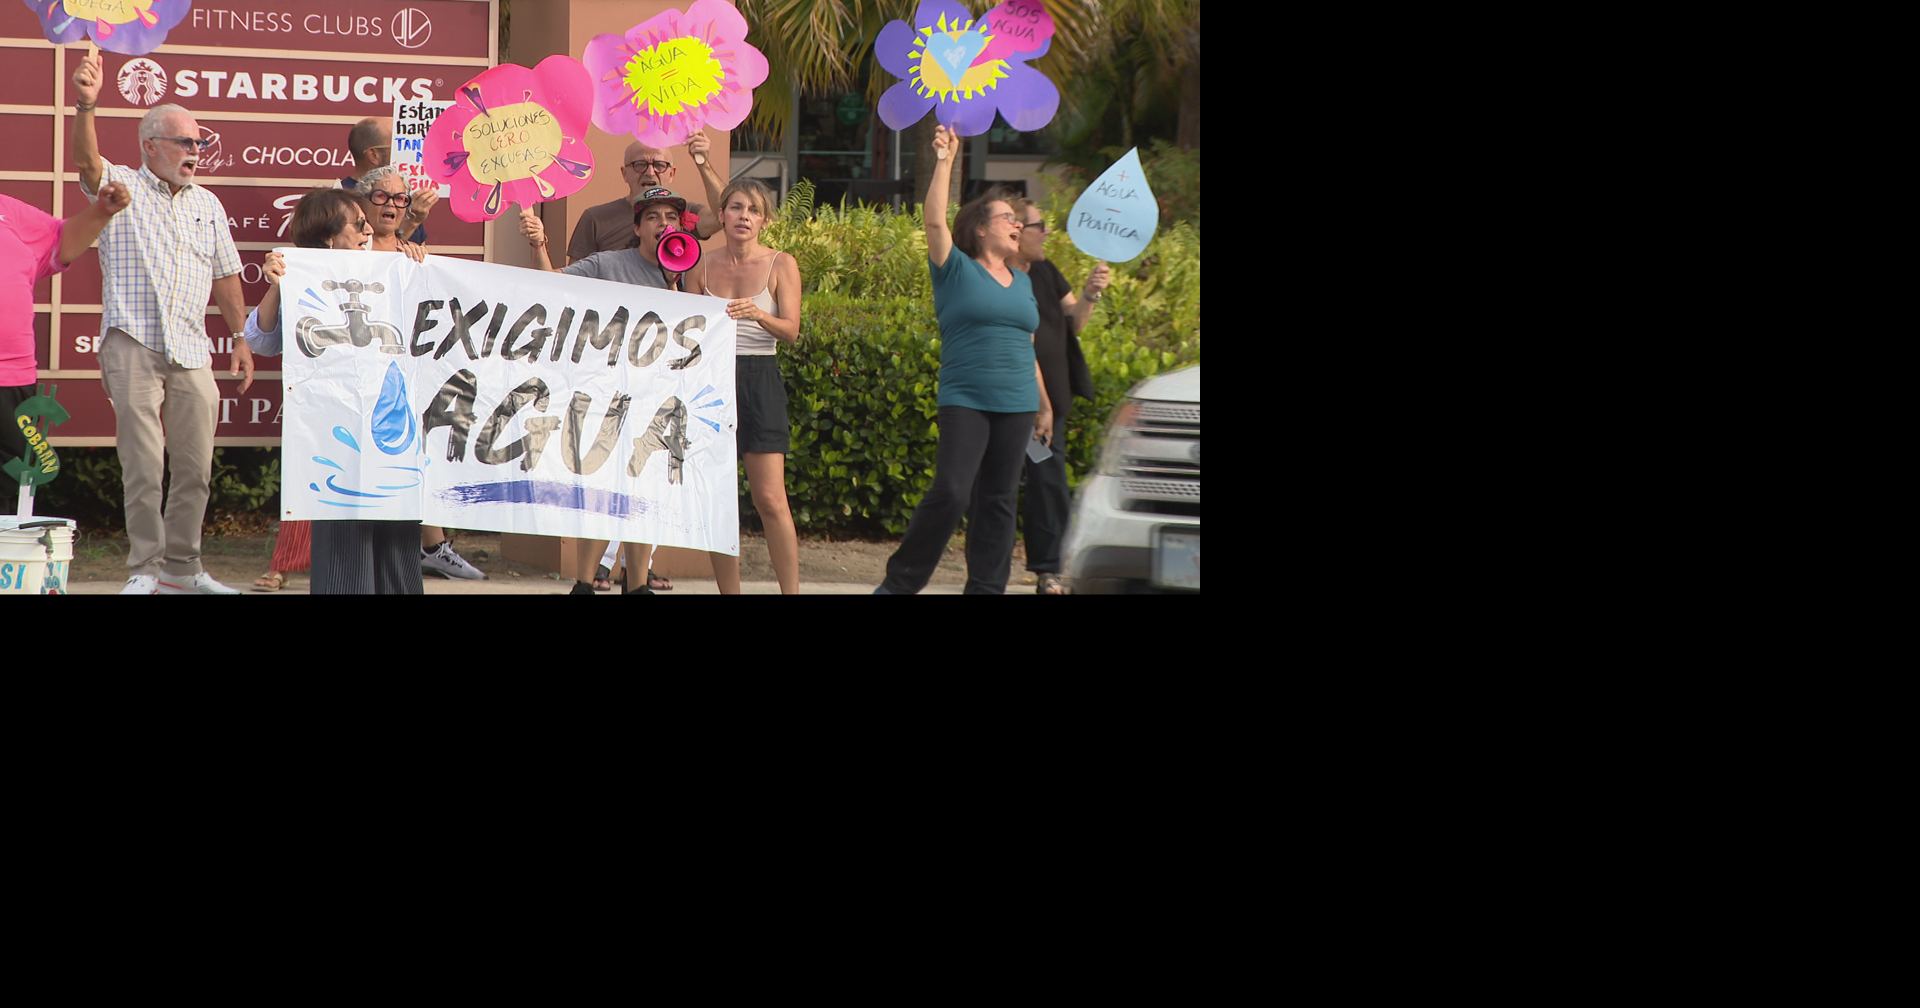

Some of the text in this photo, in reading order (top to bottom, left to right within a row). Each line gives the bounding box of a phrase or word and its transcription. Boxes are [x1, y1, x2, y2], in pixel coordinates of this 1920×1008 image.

[193, 8, 293, 33] FITNESS
[303, 13, 382, 37] CLUBS
[1004, 1, 1042, 24] SOS
[641, 46, 687, 73] AGUA
[394, 137, 425, 151] TAN
[489, 130, 531, 151] CERO
[480, 146, 547, 174] EXCUSAS
[1095, 181, 1139, 200] AGUA
[228, 213, 270, 229] AFÉ
[409, 297, 707, 370] EXIGIMOS
[422, 368, 692, 485] AGUA
[17, 415, 58, 474] COBRAN
[0, 563, 27, 589] SI
